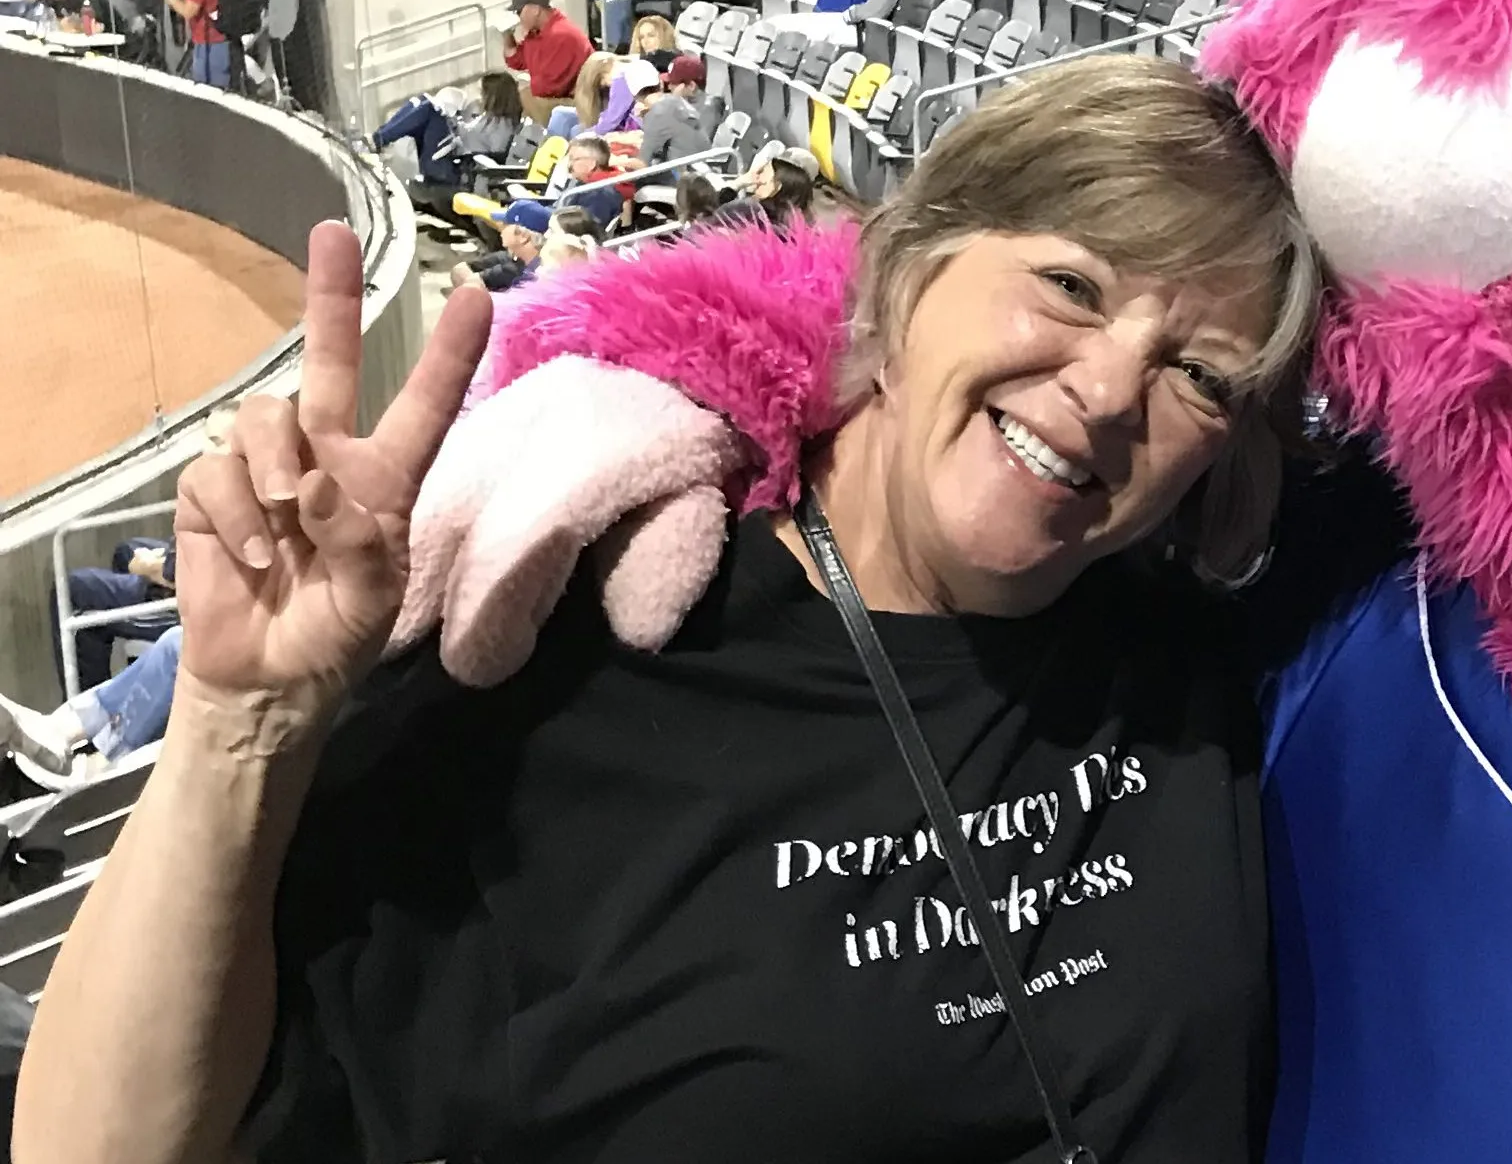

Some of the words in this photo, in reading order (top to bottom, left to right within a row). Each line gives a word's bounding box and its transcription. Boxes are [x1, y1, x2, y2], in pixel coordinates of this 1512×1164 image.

[773, 791, 1059, 889] Demoracy
[845, 913, 902, 968] in
[935, 1001, 966, 1025] The
[1059, 949, 1108, 986] Post
